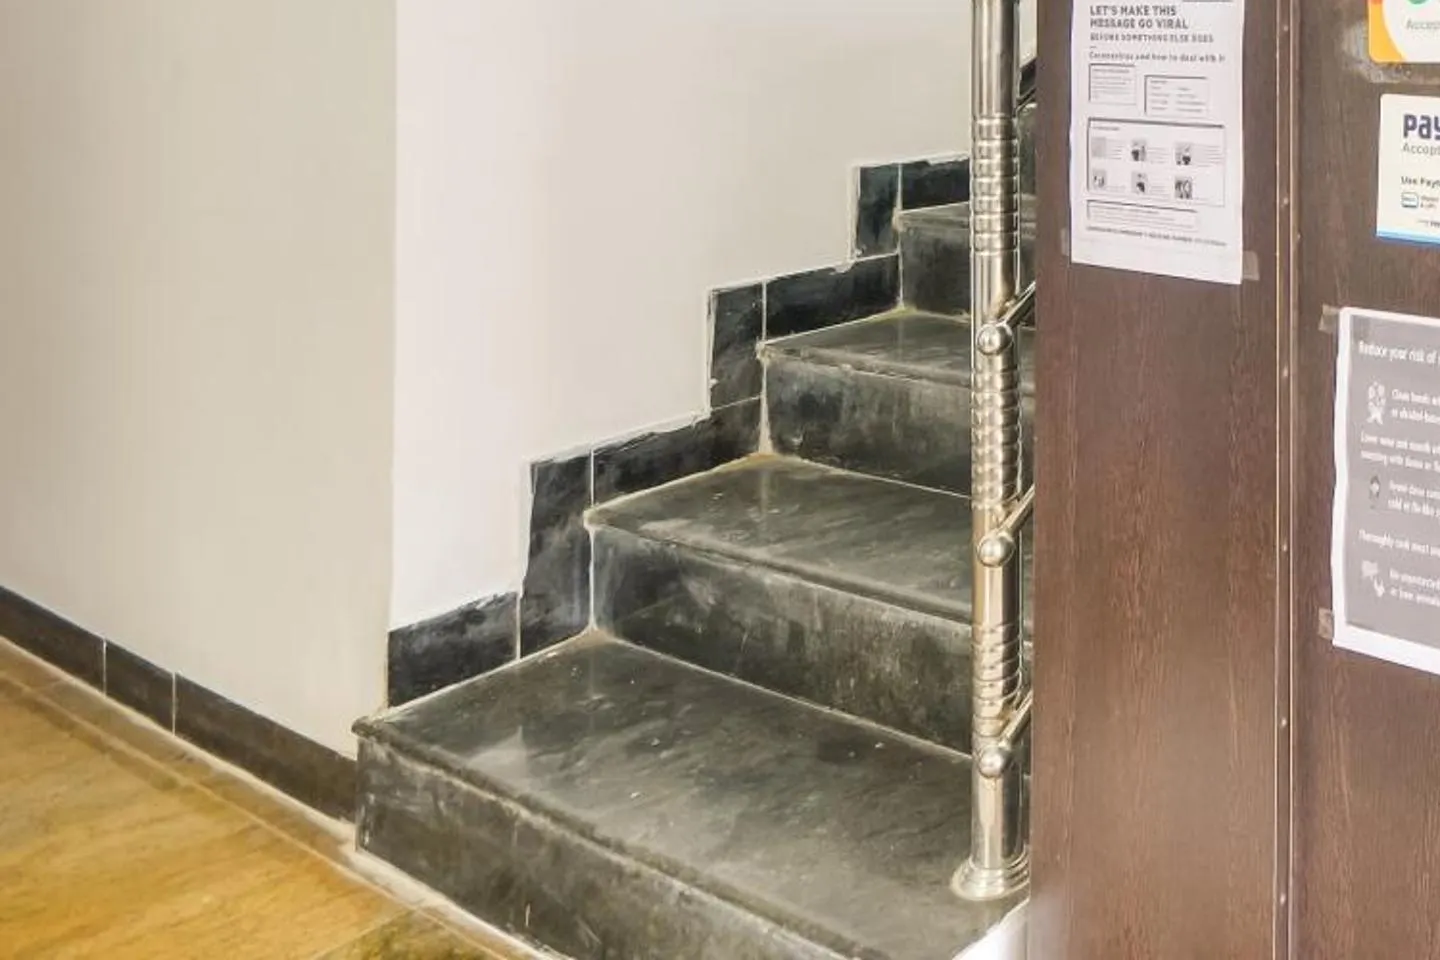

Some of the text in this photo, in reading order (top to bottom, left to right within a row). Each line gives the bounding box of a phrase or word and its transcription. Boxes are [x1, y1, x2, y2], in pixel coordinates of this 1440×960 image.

[1090, 6, 1176, 16] LET'S MAKE THIS
[1090, 18, 1189, 29] MESSAGE GO VIRAL
[1426, 350, 1438, 364] of
